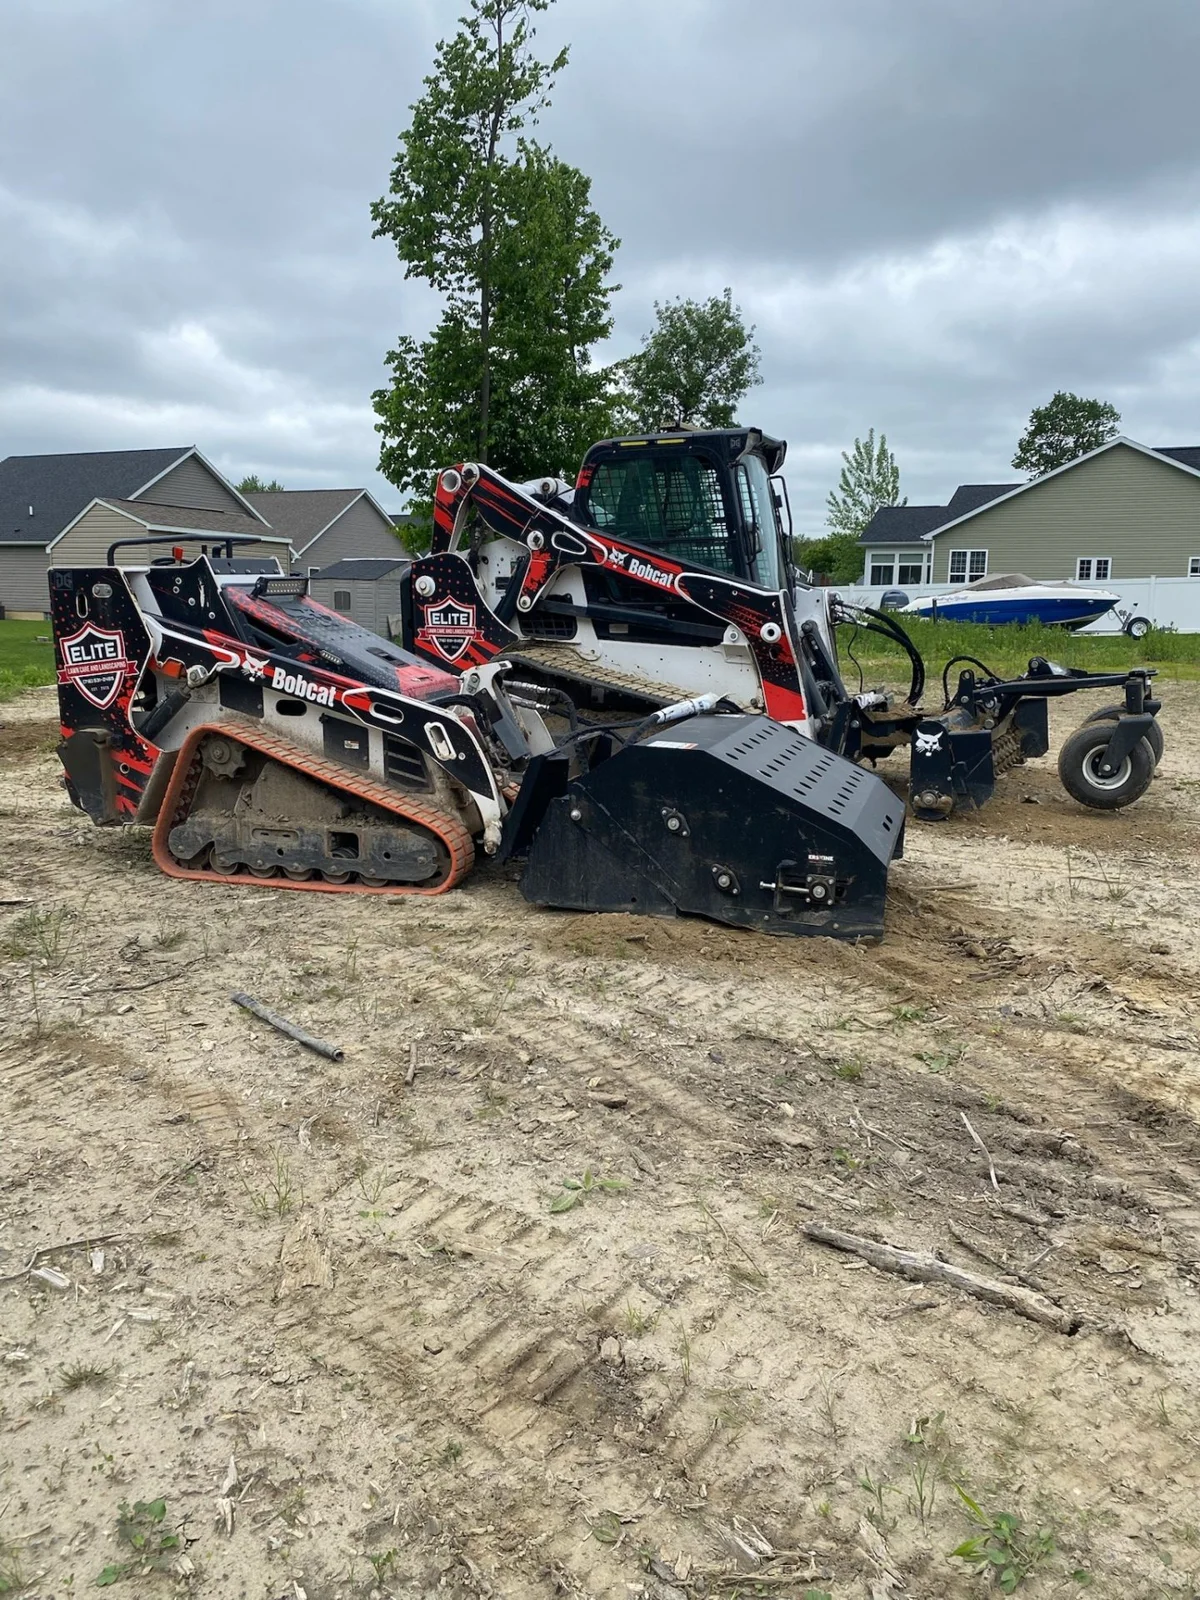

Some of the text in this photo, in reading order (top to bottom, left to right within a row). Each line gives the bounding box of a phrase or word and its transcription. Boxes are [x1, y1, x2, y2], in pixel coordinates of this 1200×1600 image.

[628, 558, 674, 588] Bobcat
[432, 613, 468, 625] ELITE
[70, 642, 116, 662] ELITE
[99, 661, 127, 671] LANDSCAPING
[271, 667, 337, 708] Bobcat
